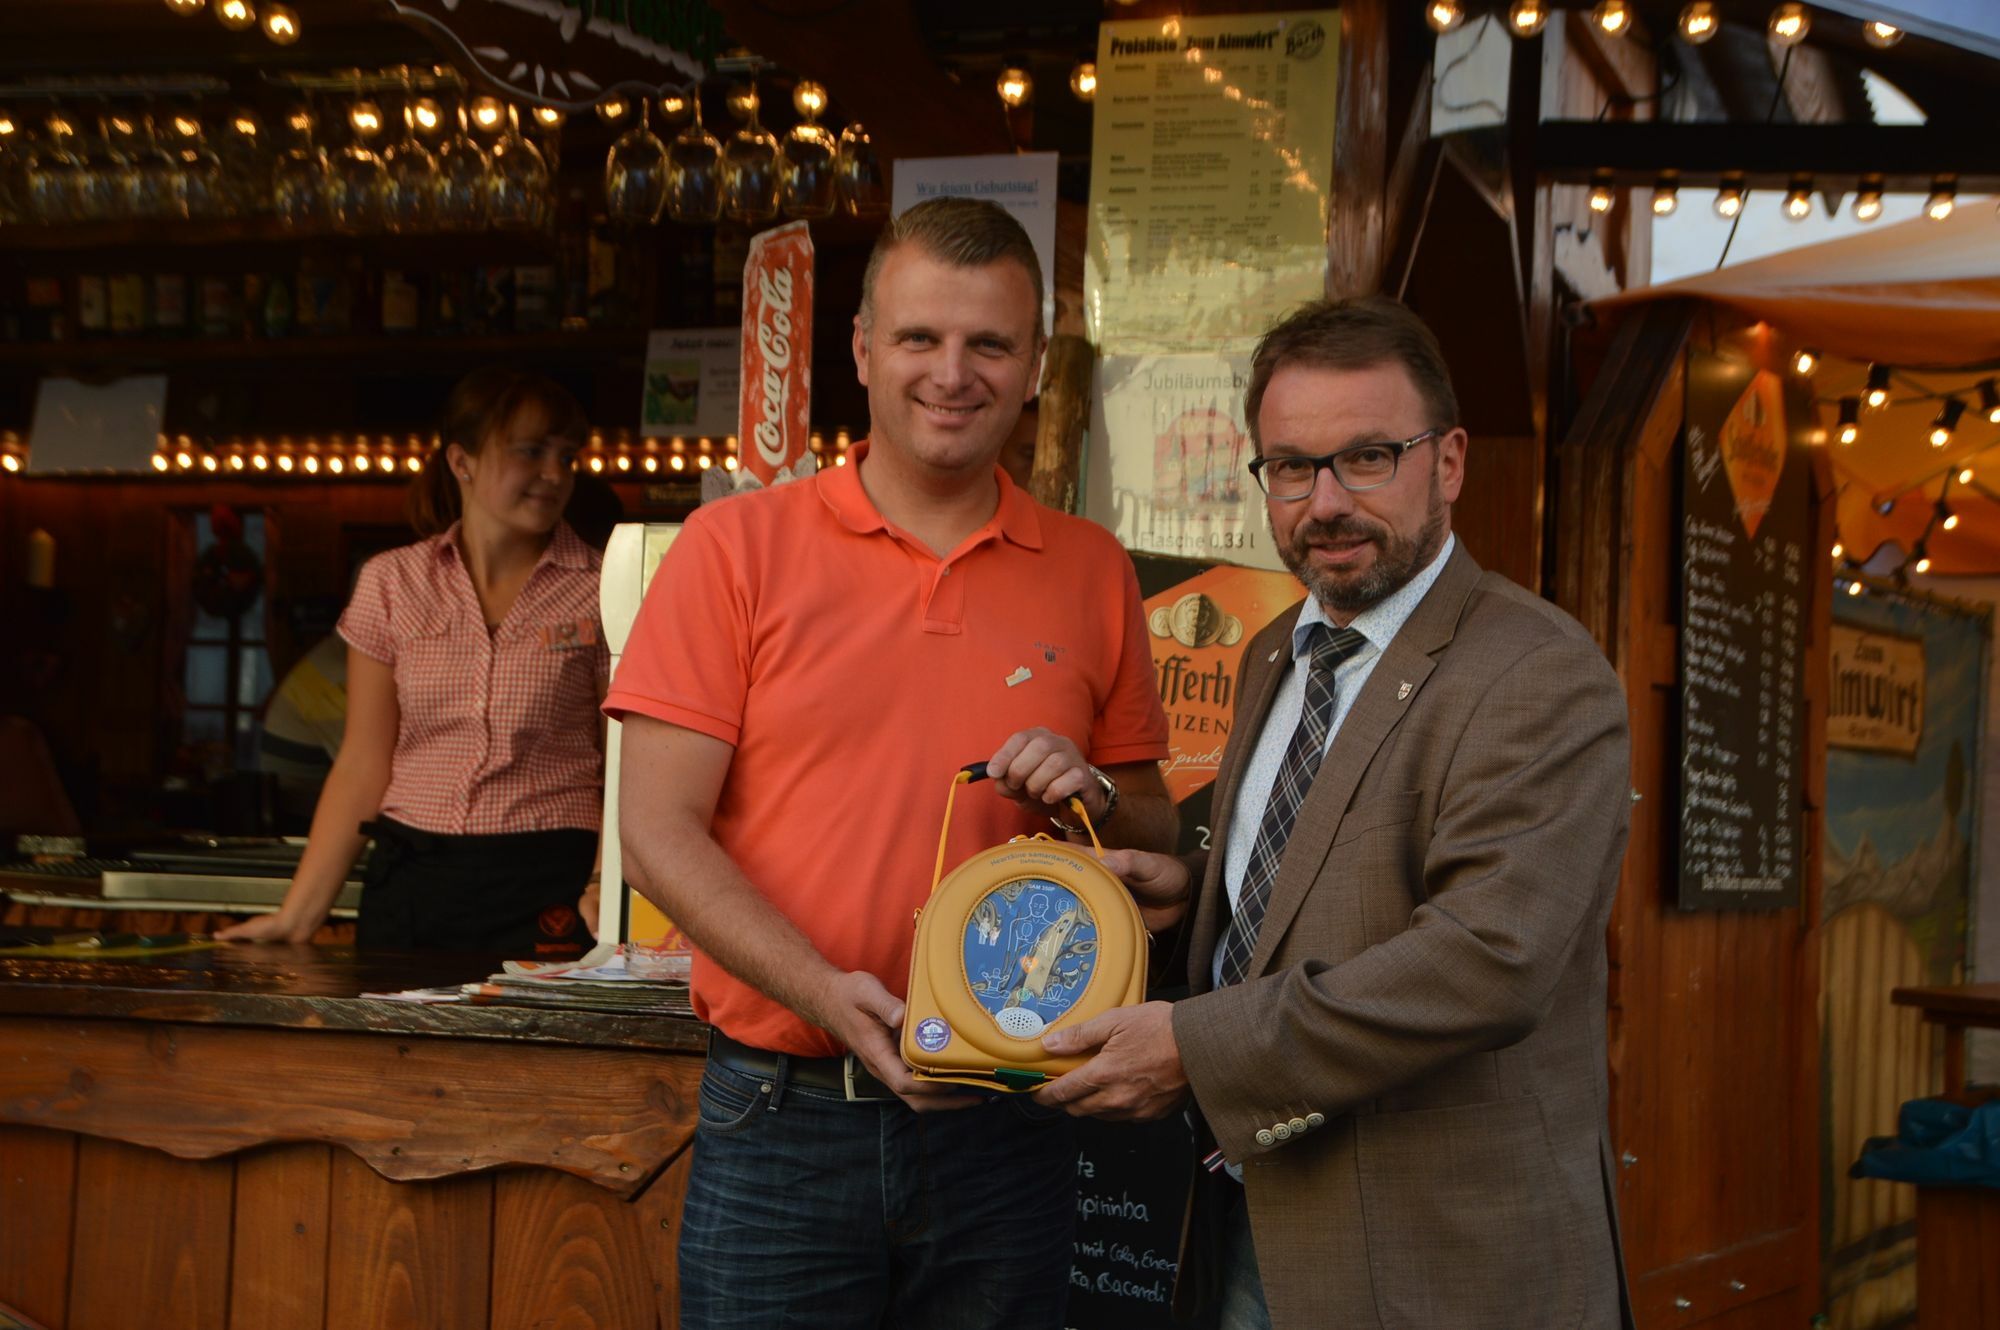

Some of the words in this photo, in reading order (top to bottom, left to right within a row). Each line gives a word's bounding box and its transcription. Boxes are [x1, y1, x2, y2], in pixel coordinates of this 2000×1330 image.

[1110, 37, 1177, 57] Preisliste
[1140, 531, 1205, 549] Flasche
[1209, 532, 1245, 550] 0,33
[1828, 651, 1918, 734] lmwirt
[1166, 711, 1230, 736] IZEN
[1068, 860, 1084, 873] PAD
[1076, 1190, 1150, 1222] ipirinha
[1082, 1241, 1106, 1258] mit
[1097, 1271, 1167, 1303] Bacardi
